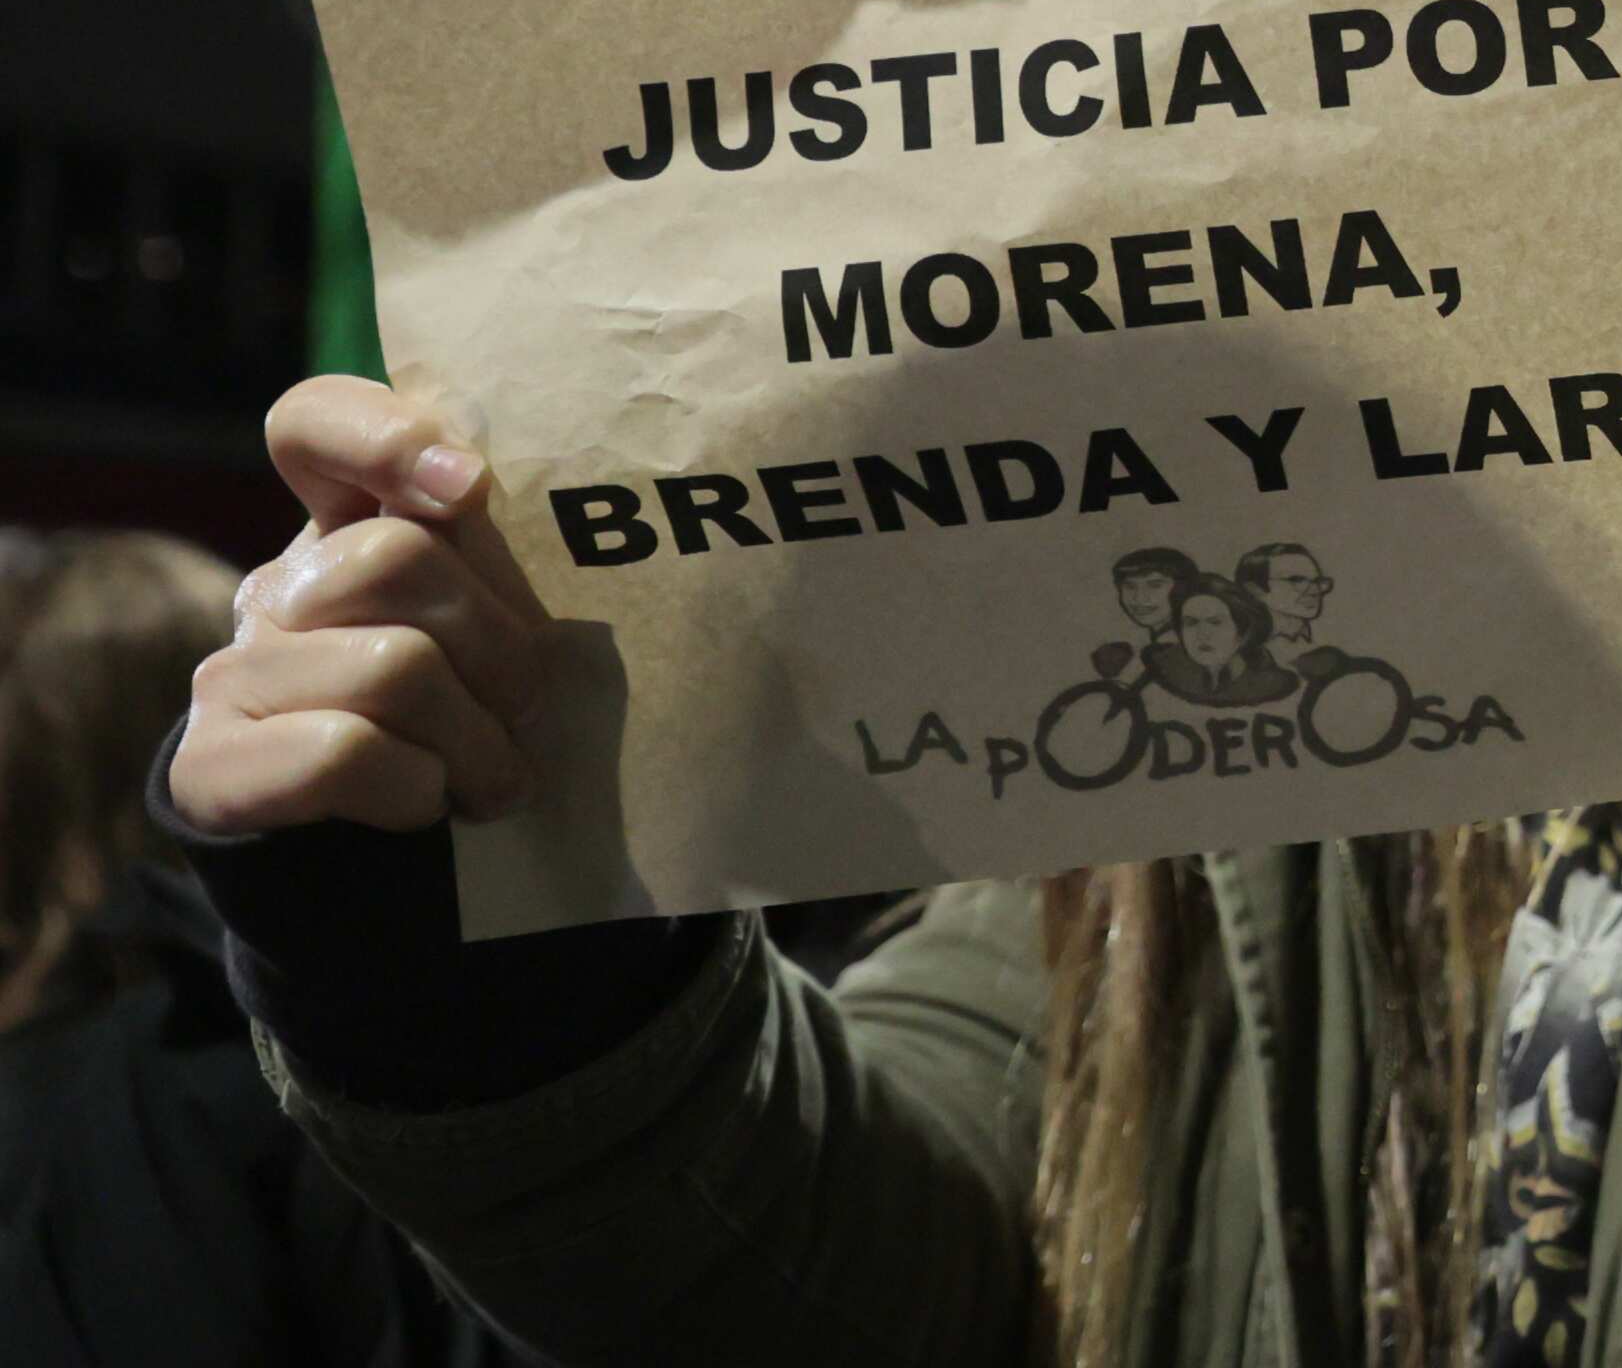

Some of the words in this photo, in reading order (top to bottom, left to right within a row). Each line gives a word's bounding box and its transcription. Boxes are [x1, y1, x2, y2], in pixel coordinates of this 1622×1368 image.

[602, 24, 1267, 180] JUSTICIA
[782, 210, 1461, 363] MORENA,
[550, 428, 1180, 566] BRENDA
[1205, 407, 1305, 492] Y
[855, 711, 968, 775] LA
